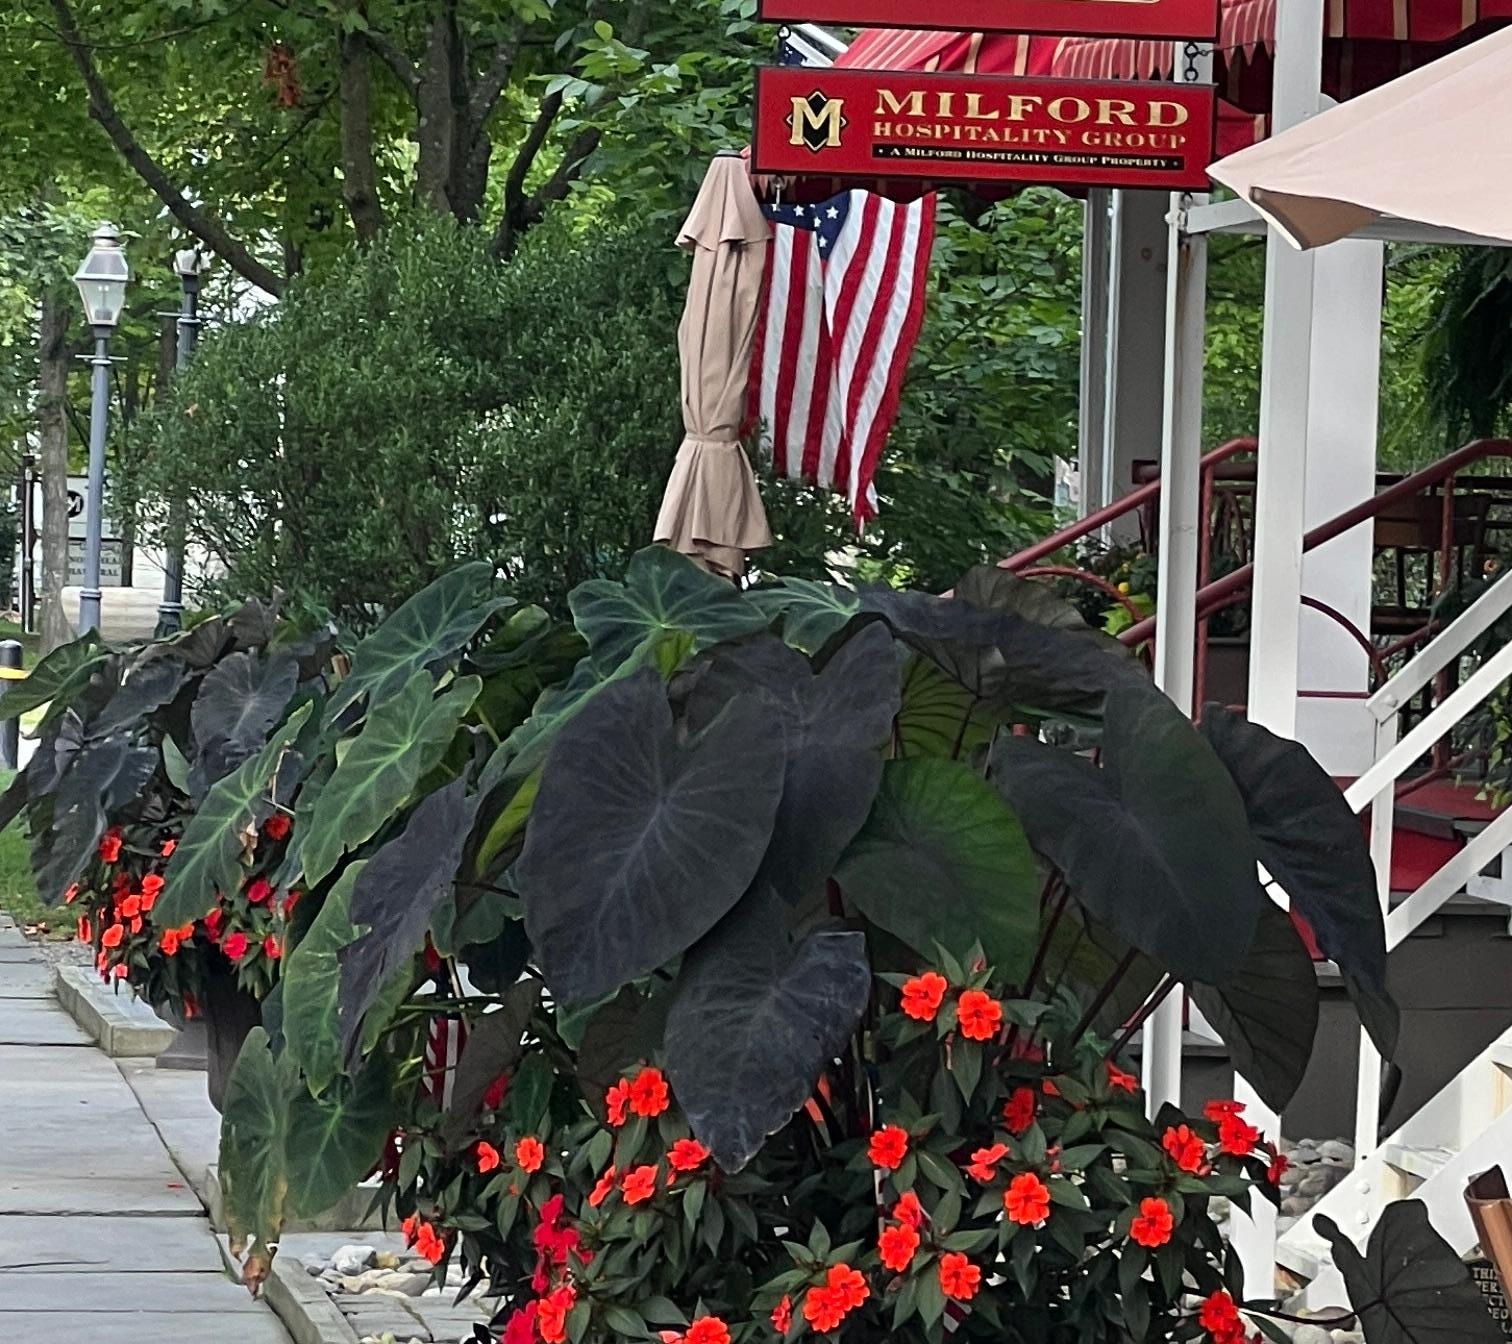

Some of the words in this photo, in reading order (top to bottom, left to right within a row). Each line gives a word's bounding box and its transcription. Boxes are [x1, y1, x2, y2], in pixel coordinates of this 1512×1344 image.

[789, 95, 845, 147] M
[873, 88, 1189, 127] MILFORD
[872, 121, 1073, 145] HOSPITALITY
[1081, 130, 1187, 149] GROUP
[889, 147, 901, 157] A
